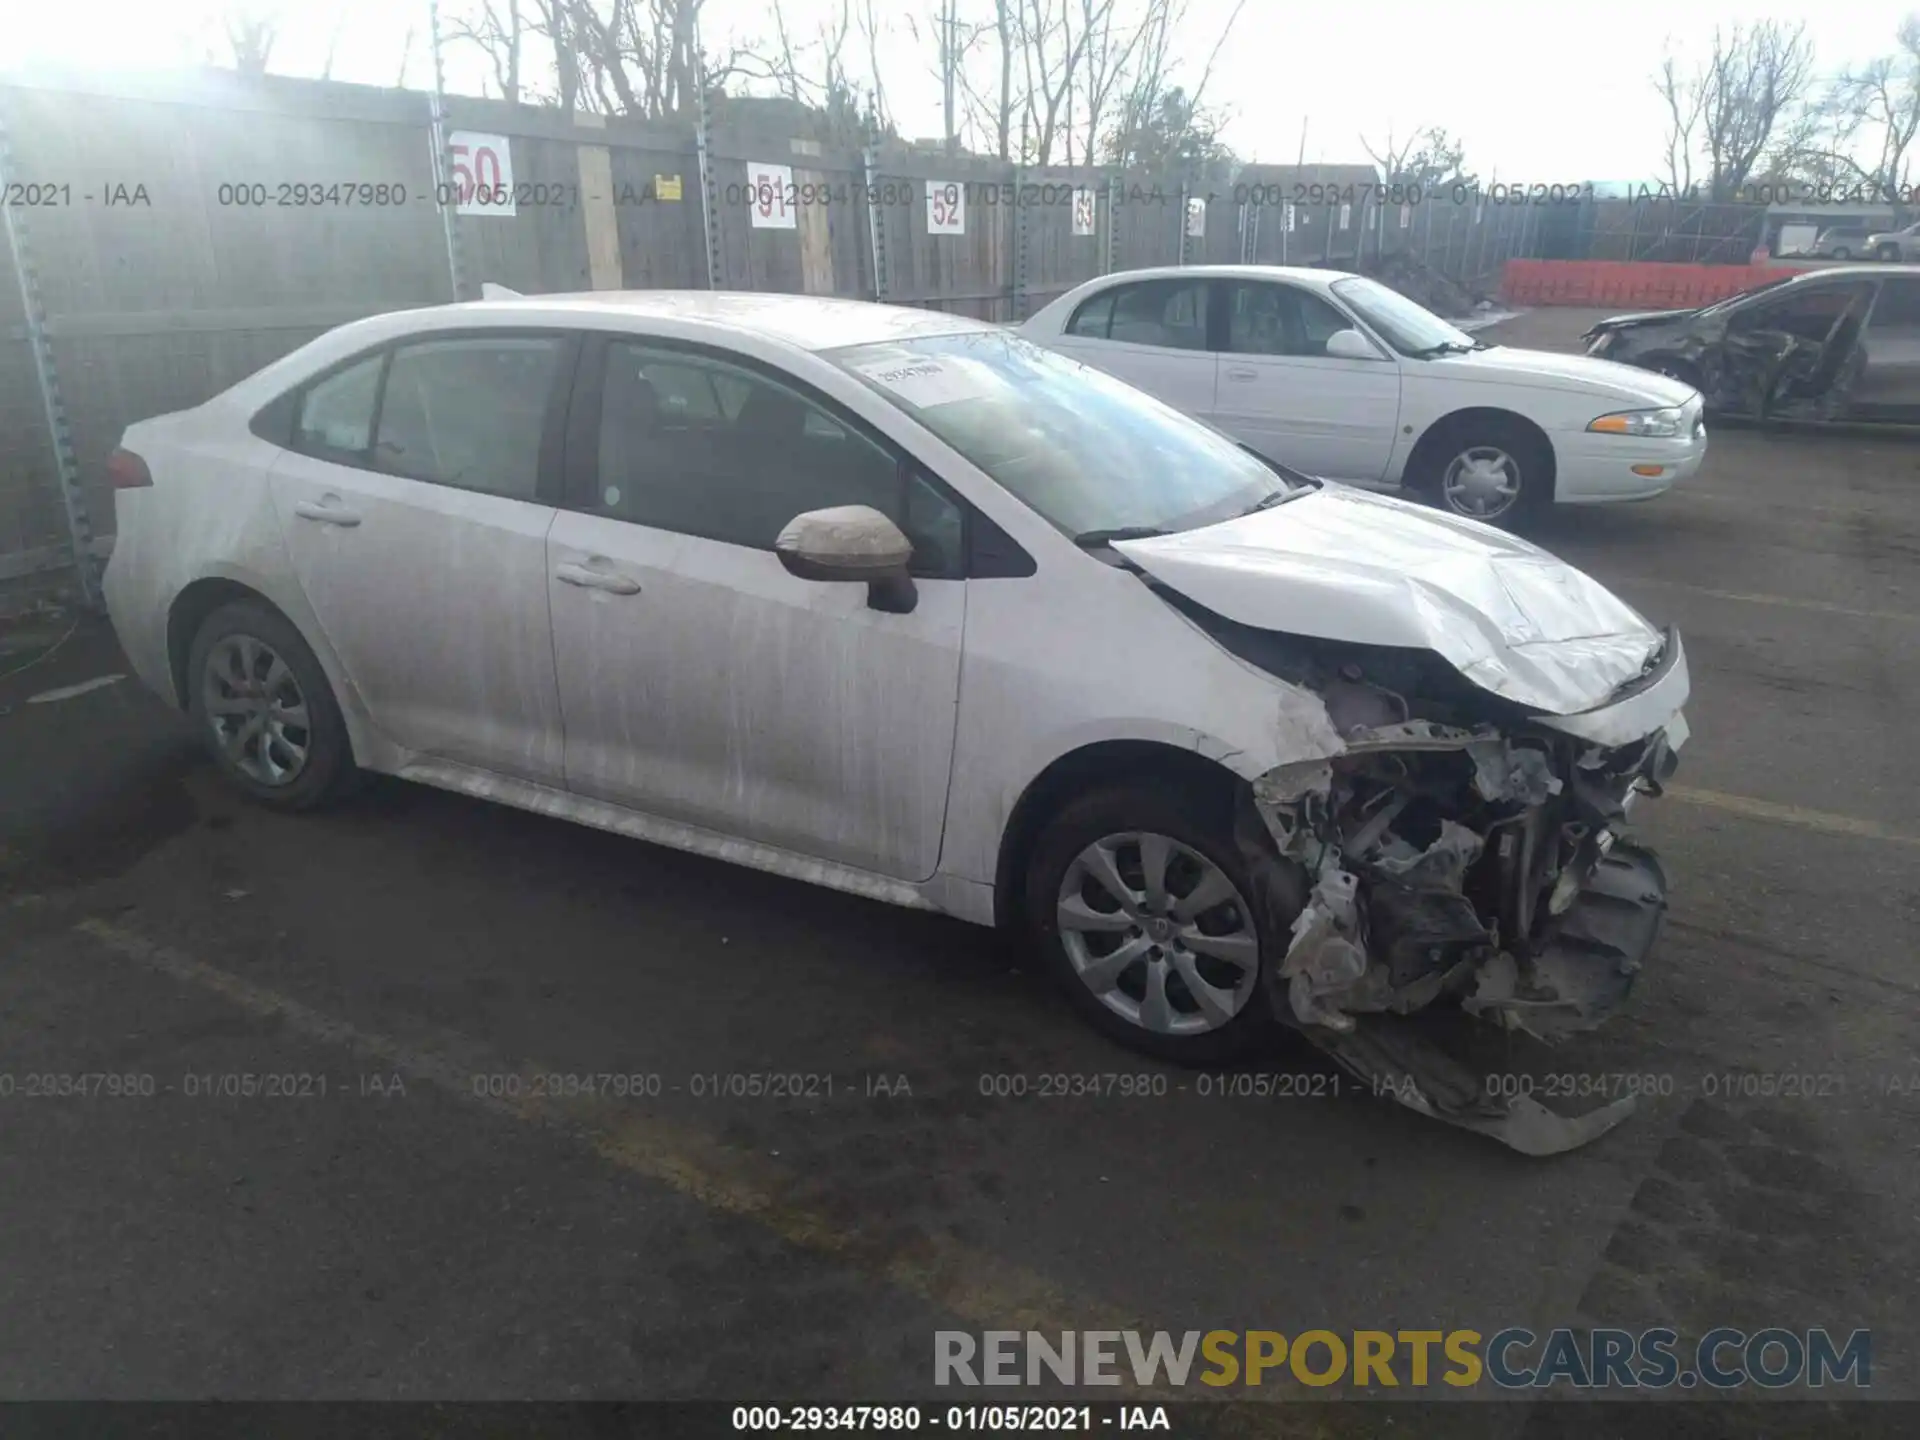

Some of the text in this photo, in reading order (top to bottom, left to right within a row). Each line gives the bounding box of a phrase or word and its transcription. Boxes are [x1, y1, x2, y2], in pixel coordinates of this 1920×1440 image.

[452, 144, 501, 203] 50
[756, 173, 786, 218] 51
[933, 190, 958, 226] 52
